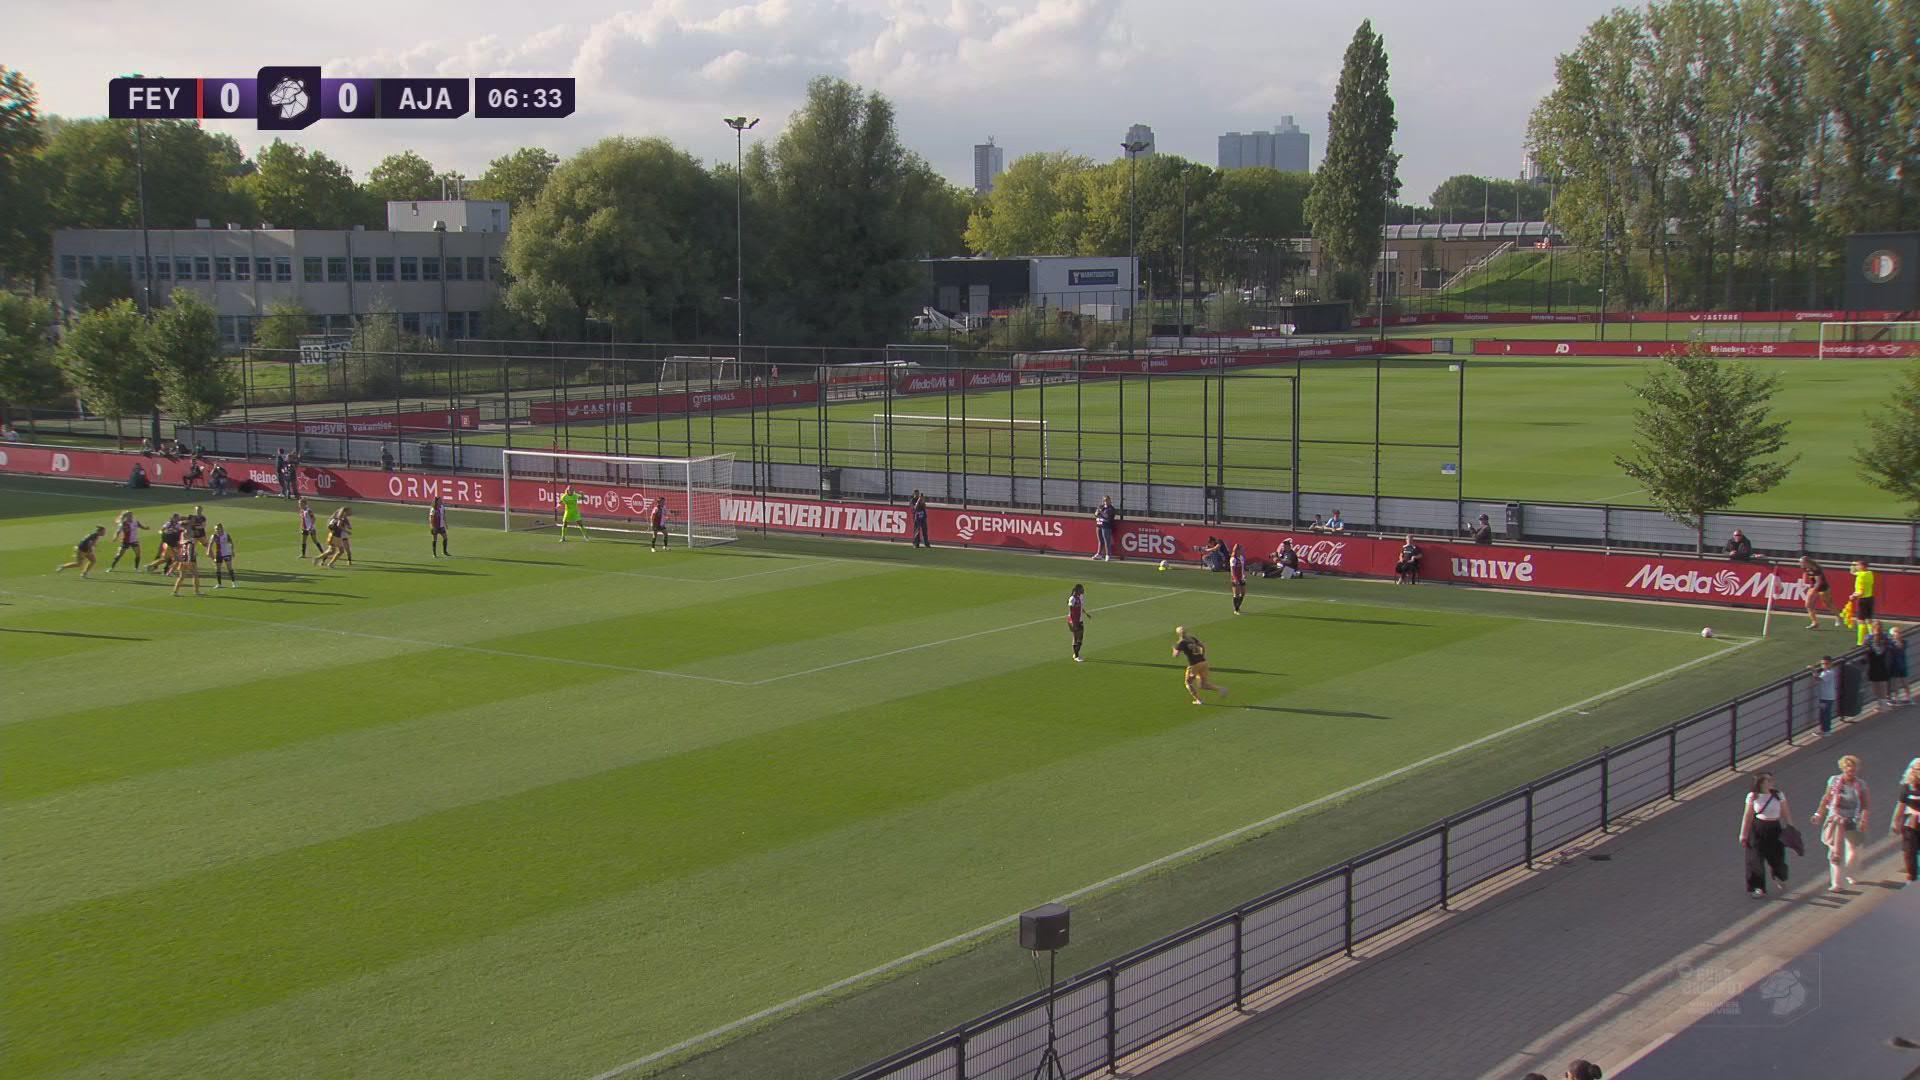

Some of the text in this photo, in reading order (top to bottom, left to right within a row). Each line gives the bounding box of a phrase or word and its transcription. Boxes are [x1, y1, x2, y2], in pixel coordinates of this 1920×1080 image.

[389, 476, 469, 501] ORMER
[719, 498, 908, 534] WHATEVER IT TAKES
[956, 514, 1063, 540] QTERMINALS
[1122, 532, 1176, 554] GERS
[1451, 554, 1534, 582] univé
[1626, 564, 1809, 601] Media Mark
